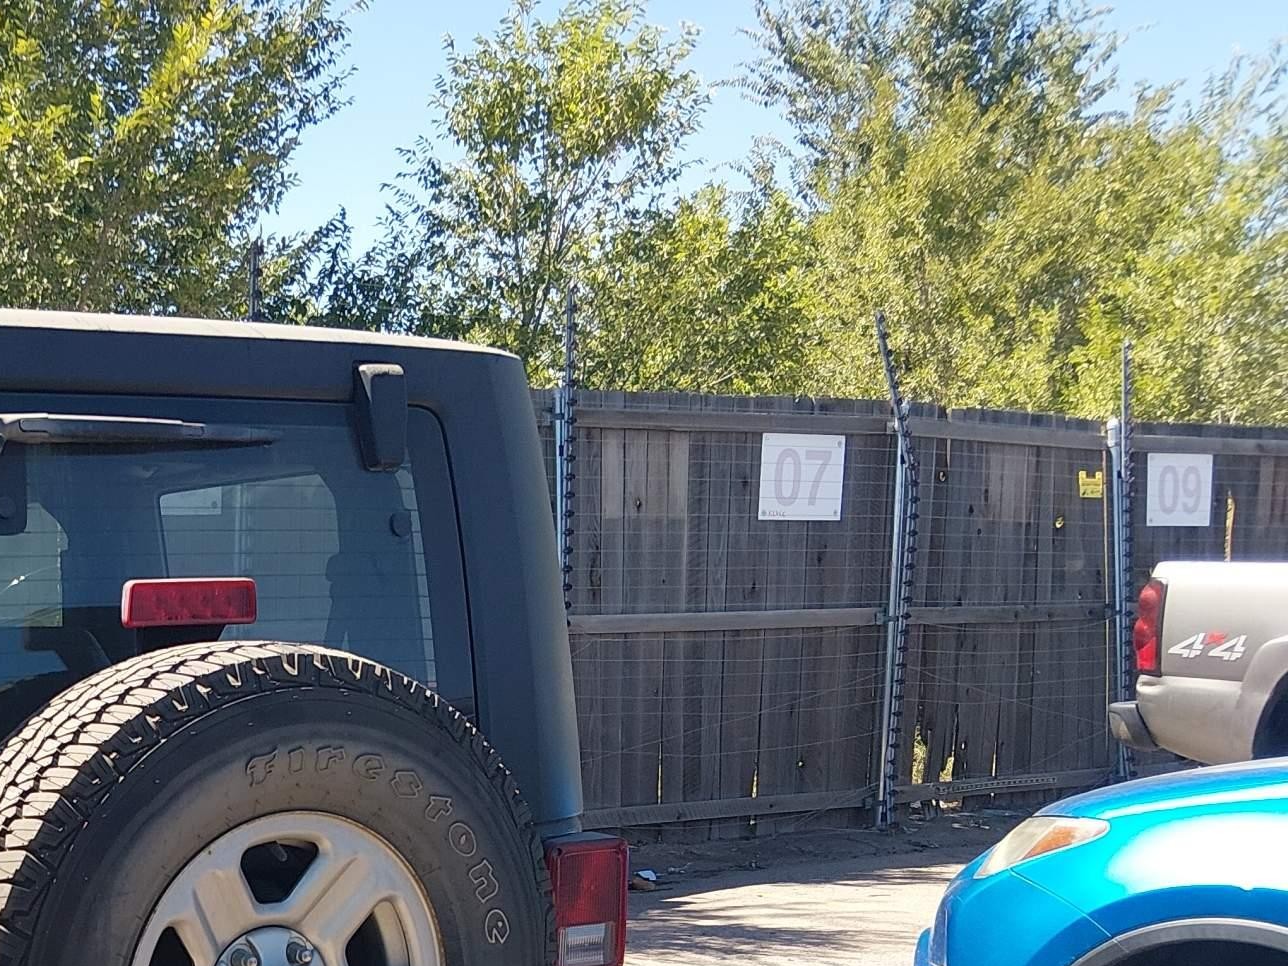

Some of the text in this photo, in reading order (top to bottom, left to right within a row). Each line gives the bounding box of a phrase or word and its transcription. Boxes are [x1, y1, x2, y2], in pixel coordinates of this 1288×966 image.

[774, 448, 832, 506] 07
[1159, 465, 1201, 514] 09
[245, 746, 509, 943] Firestone
